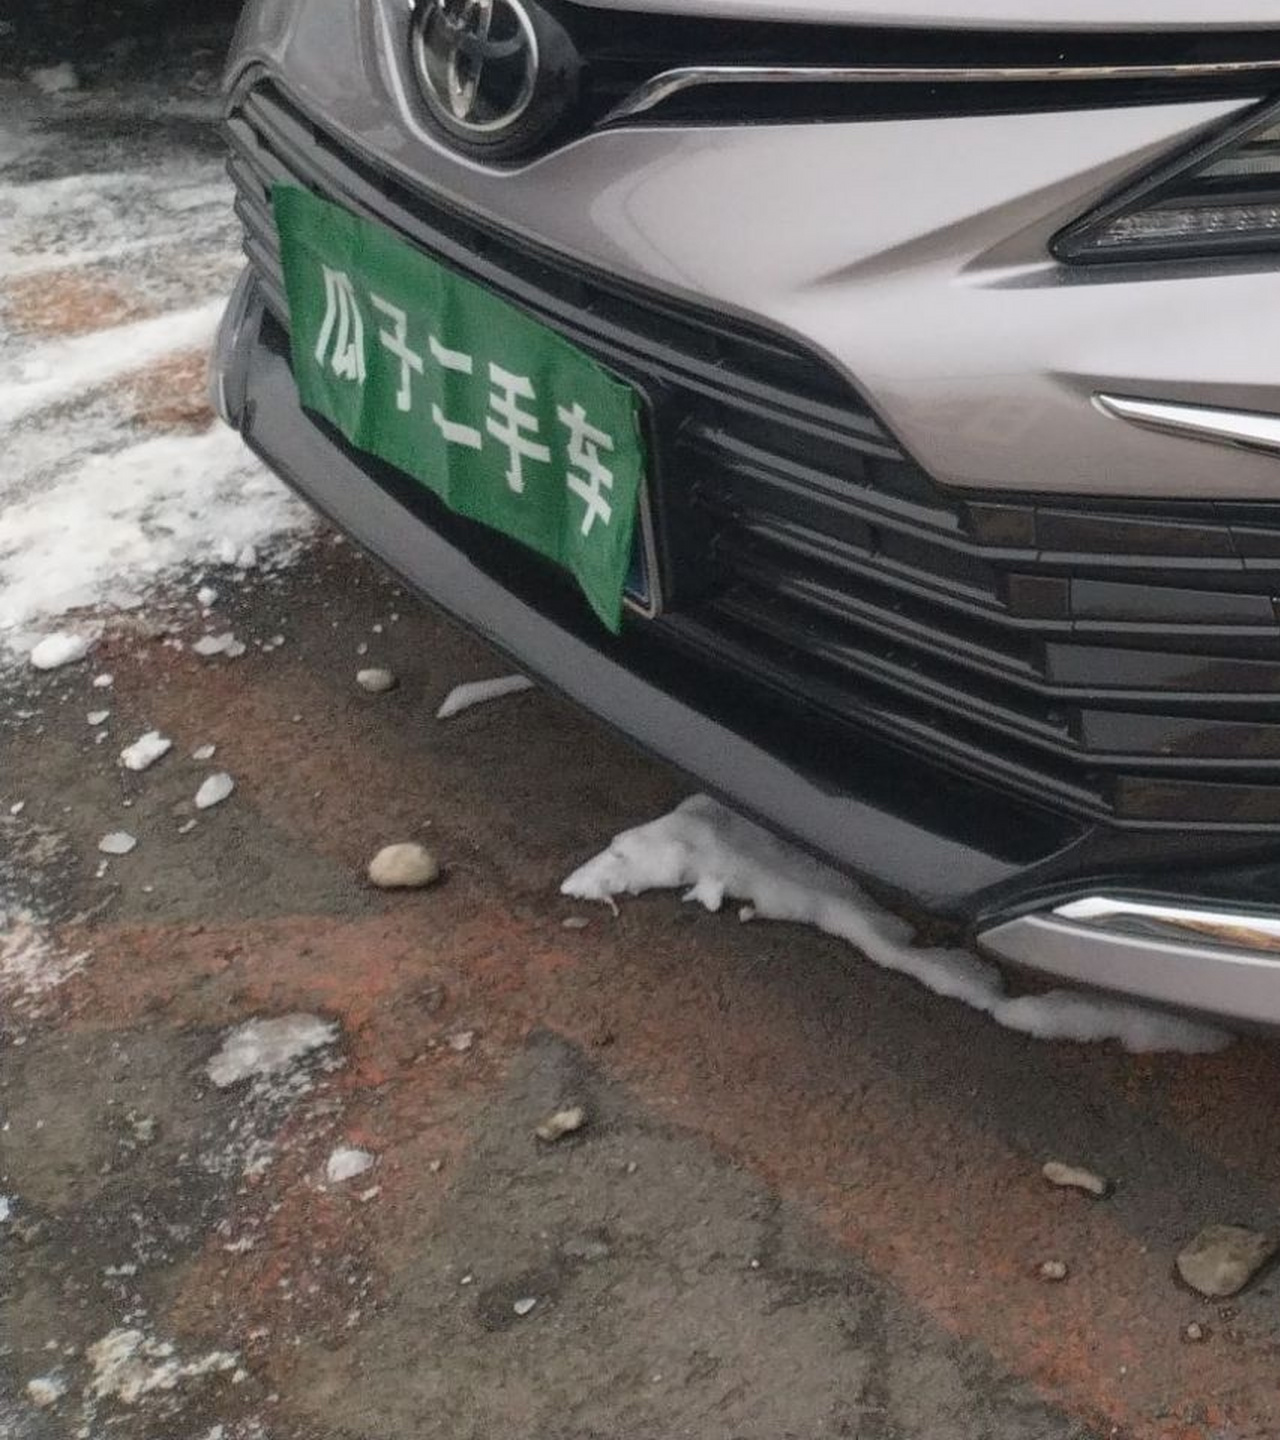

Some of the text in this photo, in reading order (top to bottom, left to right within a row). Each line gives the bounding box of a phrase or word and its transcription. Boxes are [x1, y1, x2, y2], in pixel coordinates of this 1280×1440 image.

[314, 263, 615, 537] 瓜子二手车
